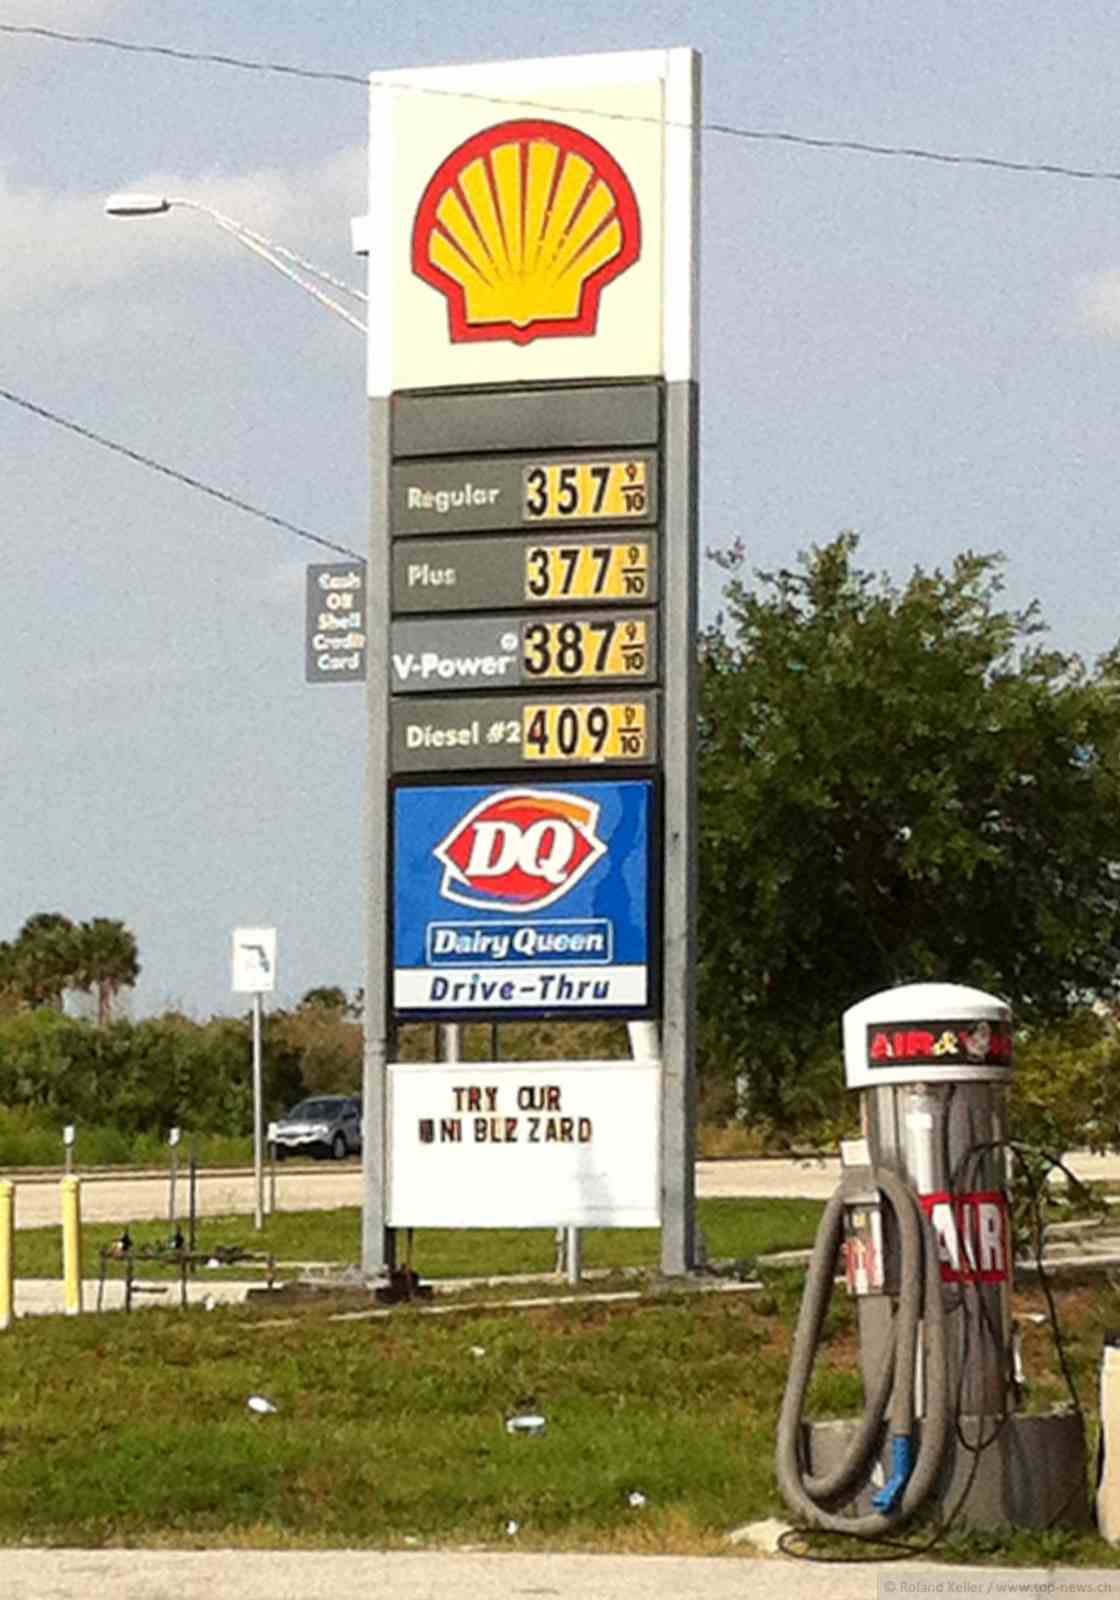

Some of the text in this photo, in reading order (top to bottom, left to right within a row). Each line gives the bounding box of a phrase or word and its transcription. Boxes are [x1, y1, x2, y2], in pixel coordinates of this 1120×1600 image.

[407, 466, 610, 516] Regular 357
[407, 549, 612, 596] Plus 377
[392, 655, 516, 680] V-Power
[524, 622, 616, 675] 387
[406, 708, 610, 755] Diesel #2 409
[464, 819, 575, 884] DQ
[433, 927, 603, 959] Dairy Queen
[430, 974, 610, 1001] Drive-Thru
[871, 1030, 934, 1058] AIR
[452, 1085, 562, 1112] TRY OUR
[931, 1203, 1002, 1274] AIR
